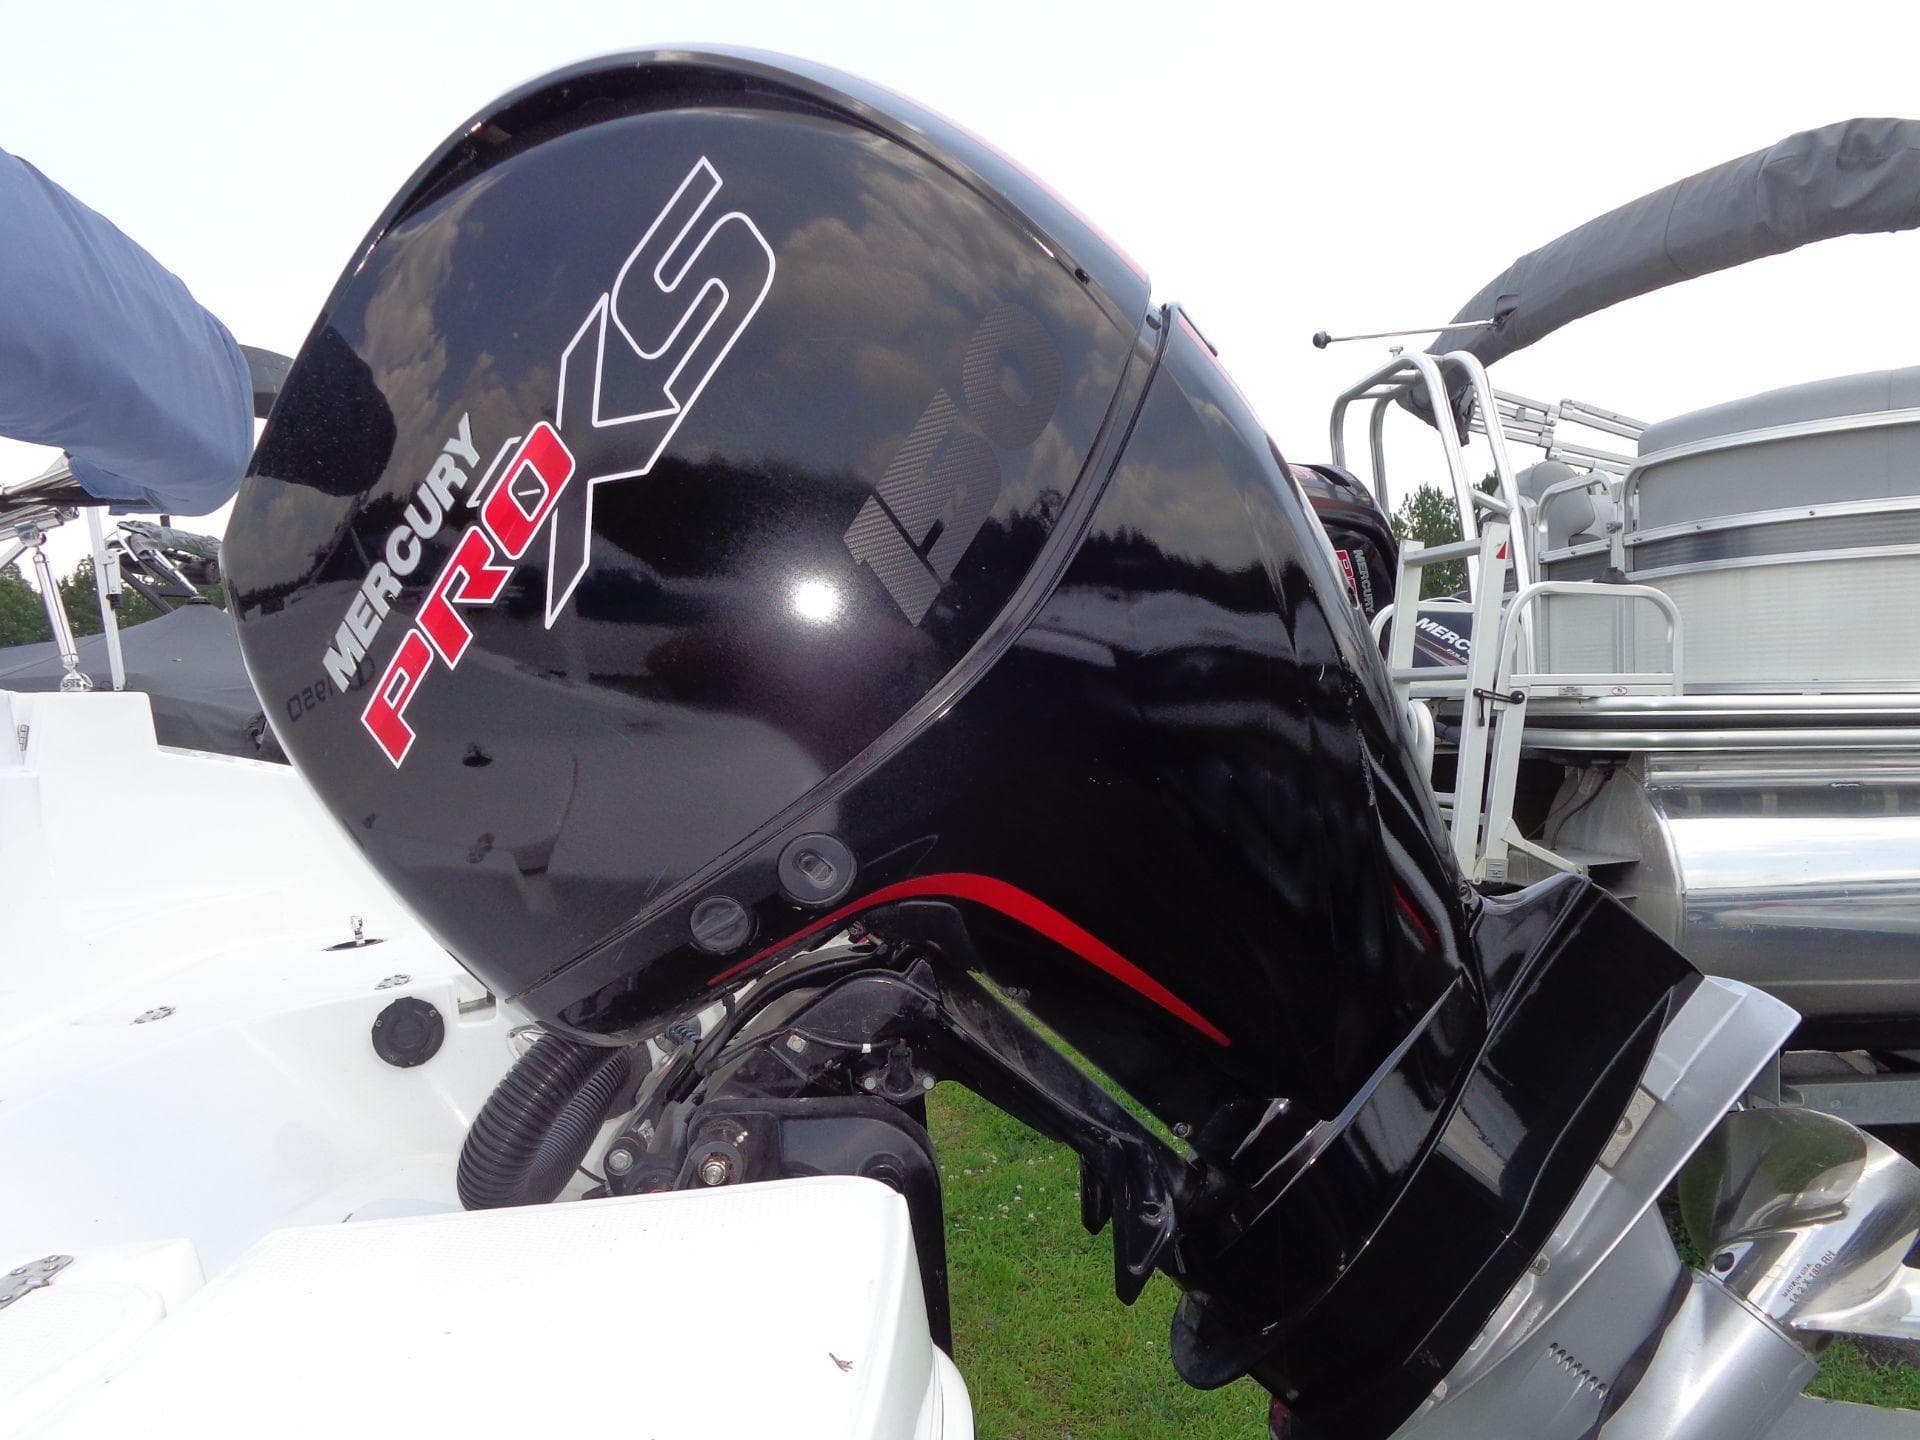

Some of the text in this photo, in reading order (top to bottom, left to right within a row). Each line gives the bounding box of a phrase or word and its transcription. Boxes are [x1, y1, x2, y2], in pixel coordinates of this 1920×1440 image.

[321, 412, 481, 693] MERCURY
[360, 420, 576, 769] PRO
[1352, 549, 1375, 613] MERCURY
[1415, 617, 1471, 655] MERC
